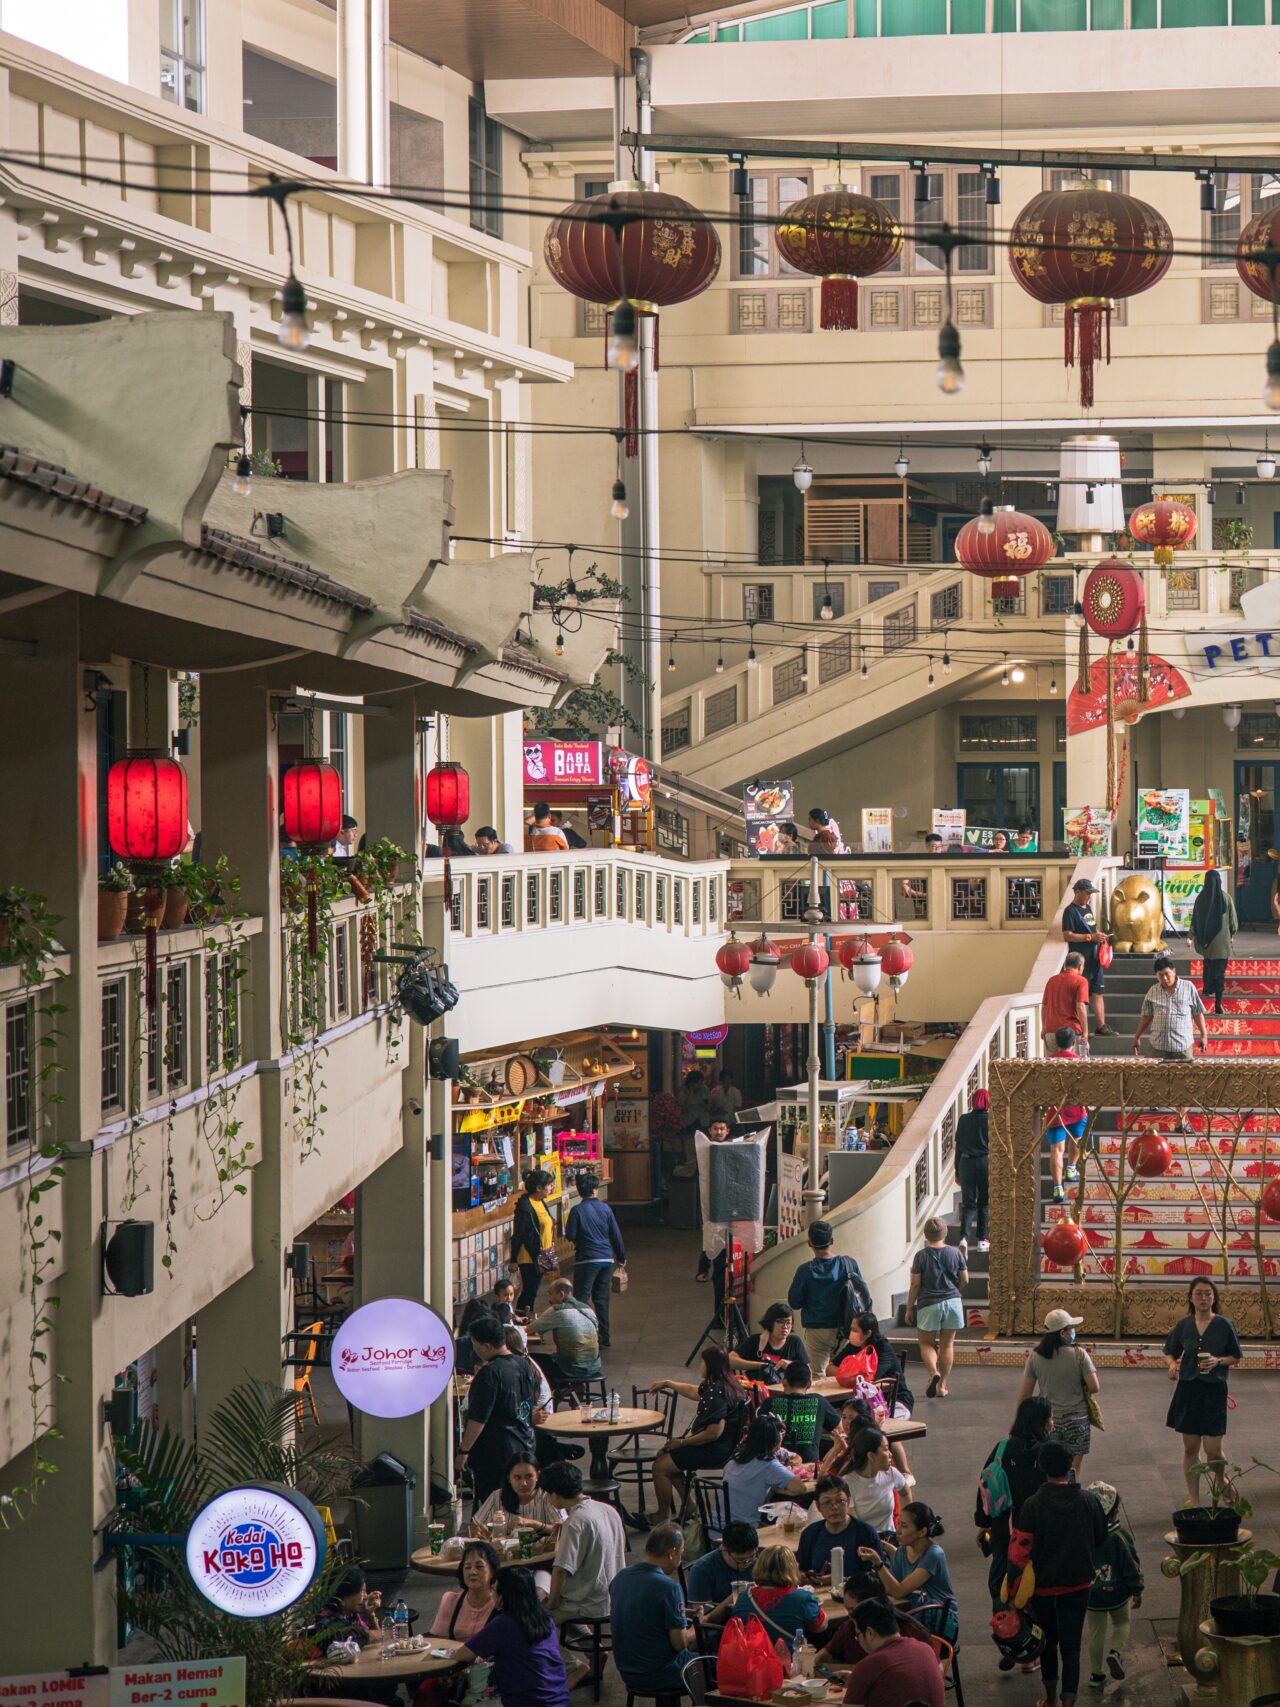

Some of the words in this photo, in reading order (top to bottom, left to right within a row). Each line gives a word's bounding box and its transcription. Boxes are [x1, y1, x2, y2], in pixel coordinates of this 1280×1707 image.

[1003, 531, 1033, 560] 福
[361, 1347, 418, 1361] Johor
[790, 1414, 816, 1423] JITSU
[226, 1528, 266, 1546] Kedai
[0, 1683, 37, 1698] akan
[41, 1678, 86, 1693] LOMIE
[124, 1672, 172, 1686] Makan
[131, 1688, 173, 1704] Ber-2
[177, 1685, 217, 1700] cuma
